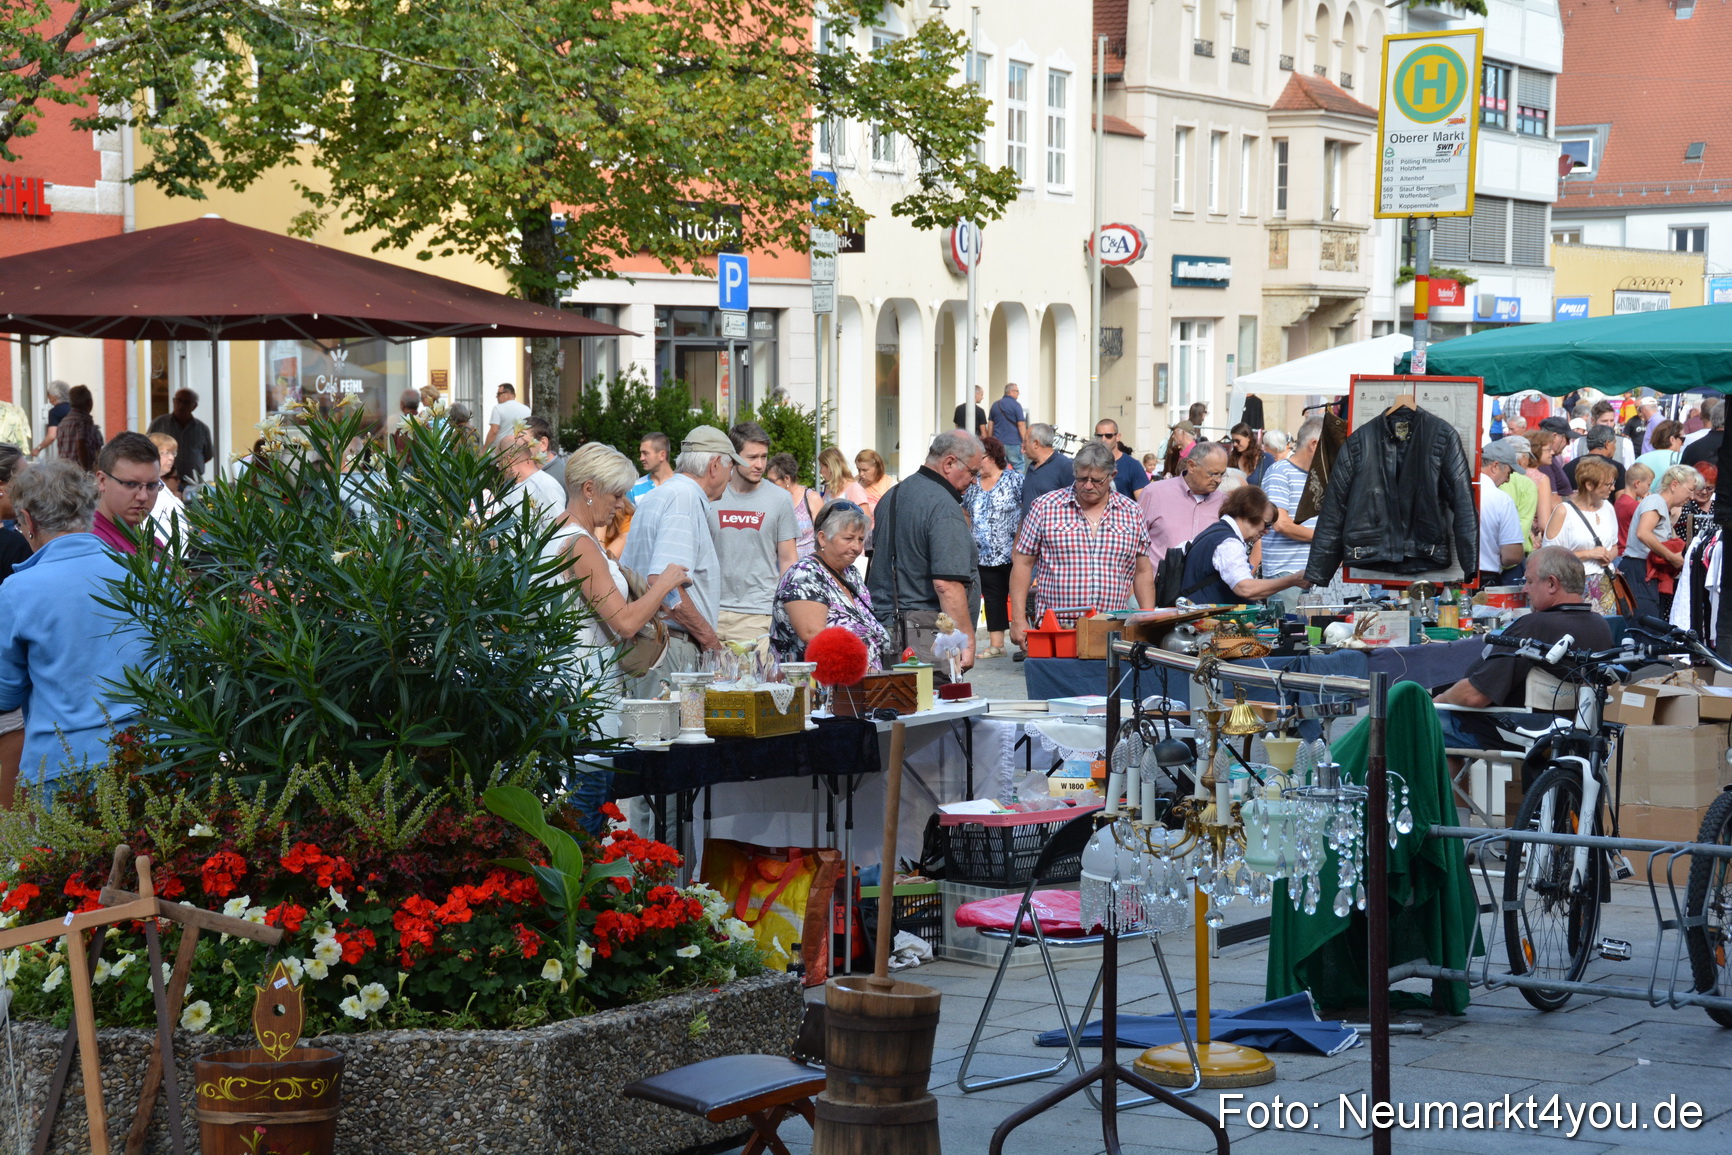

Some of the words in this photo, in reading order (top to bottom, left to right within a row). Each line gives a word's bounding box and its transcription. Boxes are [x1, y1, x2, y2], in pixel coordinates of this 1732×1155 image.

[1413, 63, 1448, 105] H
[1390, 132, 1428, 144] Oberer
[1432, 130, 1464, 142] Markt
[0, 173, 52, 216] iHL
[1100, 236, 1131, 254] C&A
[726, 262, 742, 302] P
[1558, 303, 1586, 313] APOLLO
